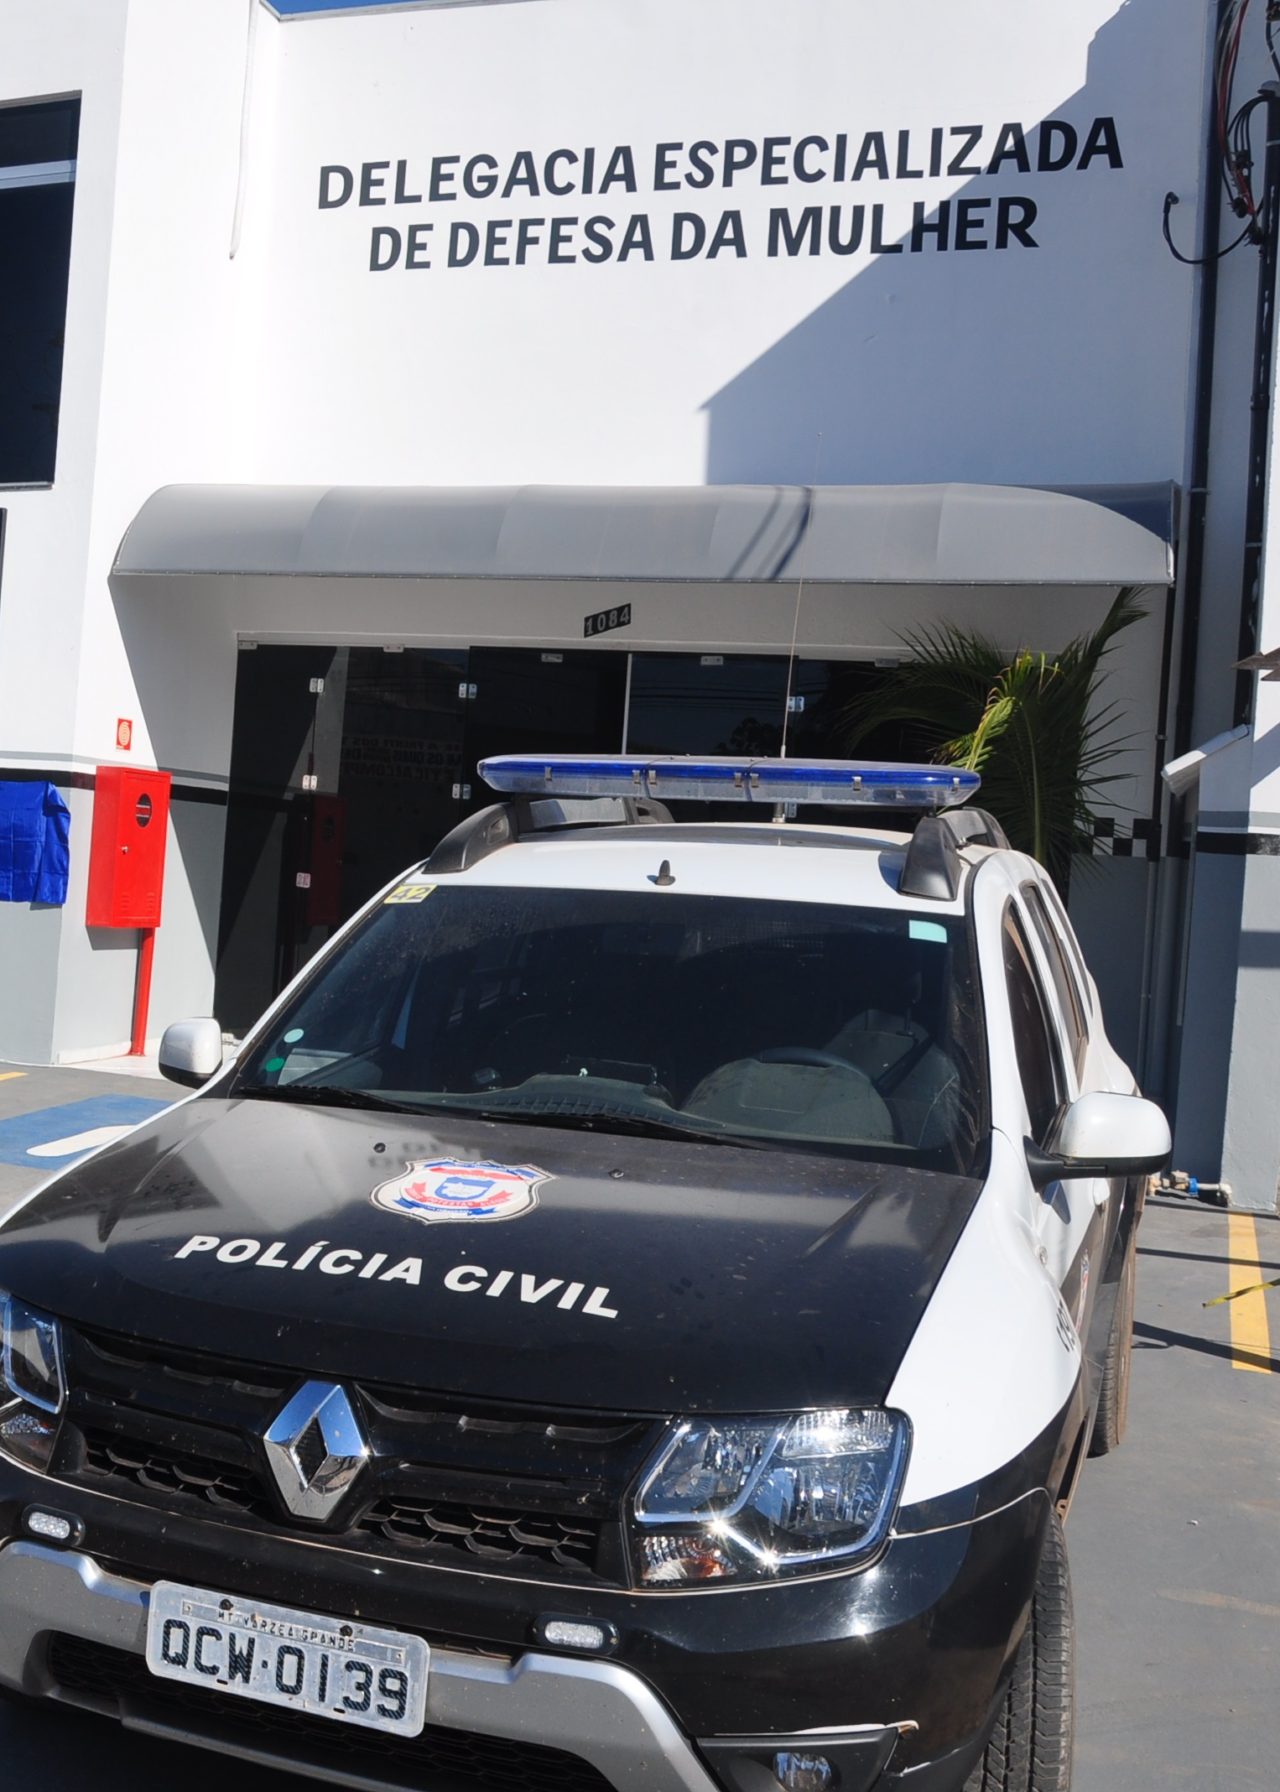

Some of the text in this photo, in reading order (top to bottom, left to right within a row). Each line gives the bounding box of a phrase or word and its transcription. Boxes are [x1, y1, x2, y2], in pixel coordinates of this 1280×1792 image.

[319, 116, 1124, 210] DELEGACIA ESPECIALIZADA
[370, 196, 1040, 271] DE DEFESA DA MULHER
[586, 606, 630, 635] 1084
[391, 886, 432, 900] 42
[174, 1234, 619, 1319] POLÍCIA CIVIL
